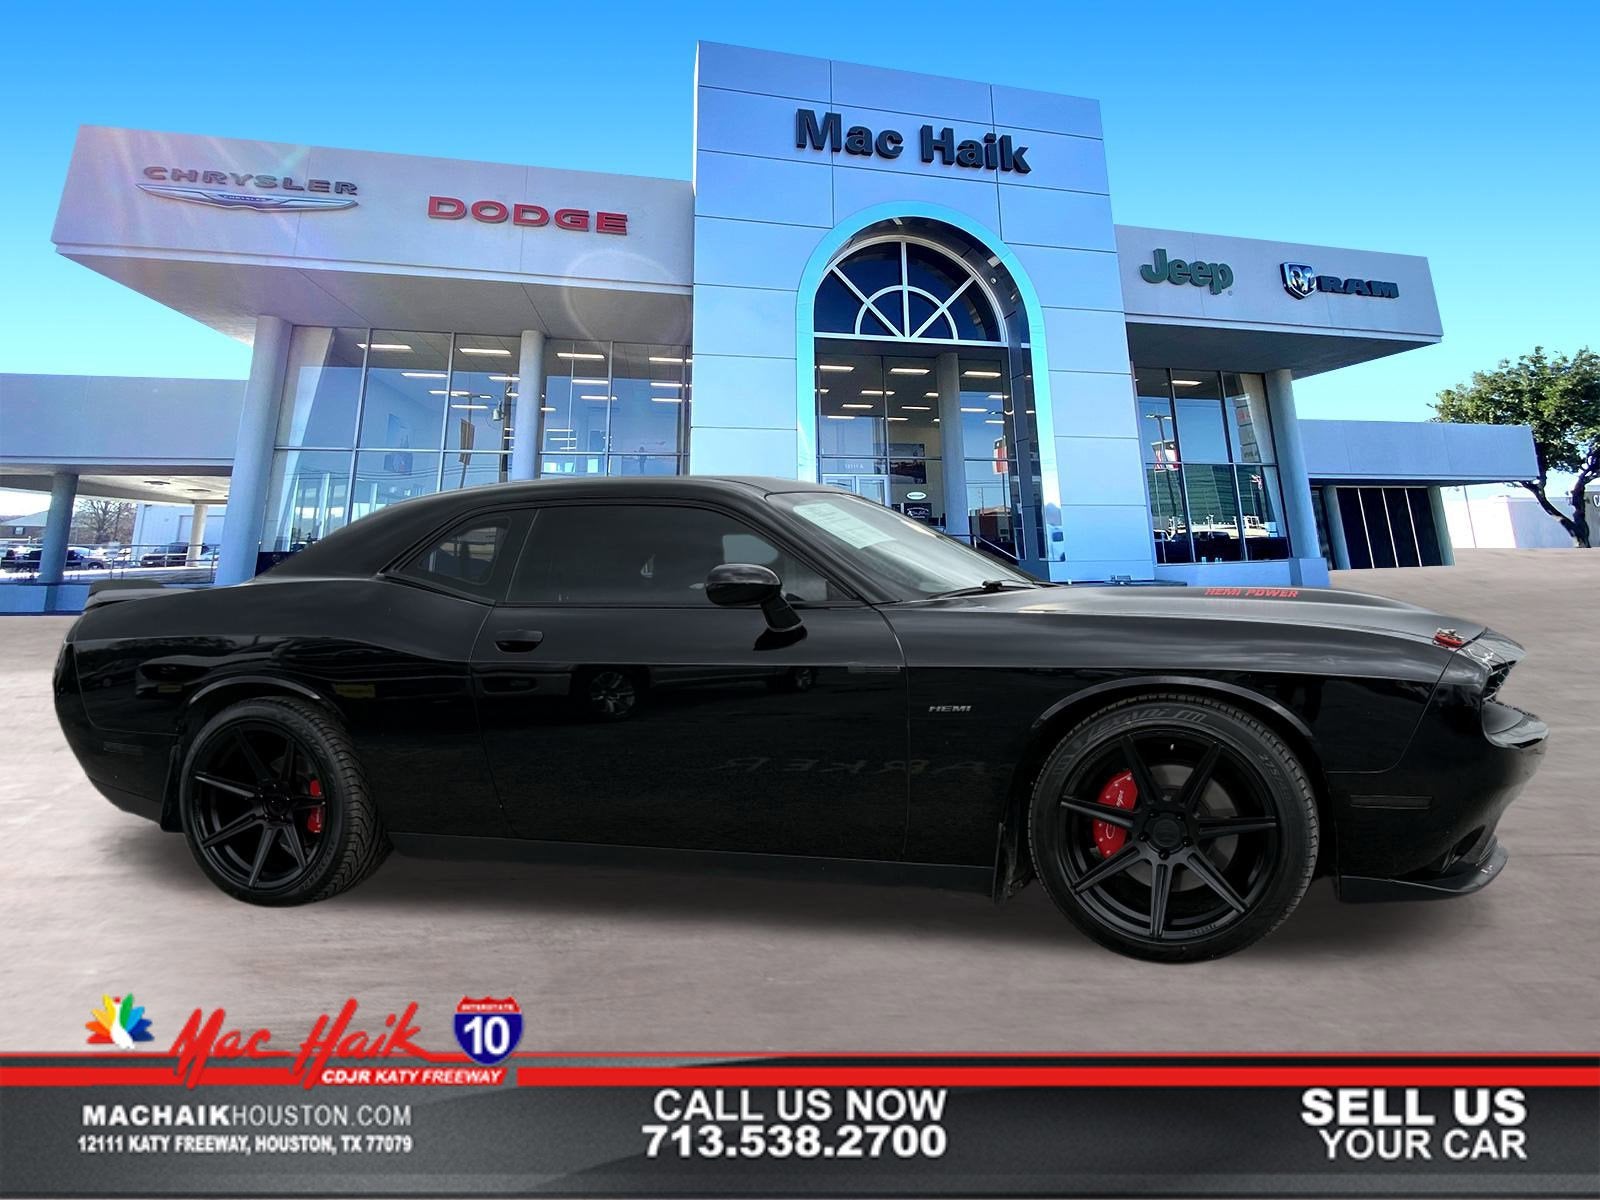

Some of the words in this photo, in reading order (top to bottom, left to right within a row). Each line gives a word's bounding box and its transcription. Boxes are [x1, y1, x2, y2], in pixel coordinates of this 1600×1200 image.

[795, 108, 904, 159] Mac
[919, 125, 1032, 174] Haik
[143, 166, 359, 196] CHRYSLER
[428, 195, 628, 236] DODGE
[1139, 248, 1234, 295] Jeep
[1315, 275, 1399, 299] RAM
[1204, 587, 1242, 597] HEMI
[1245, 588, 1299, 598] POWER
[928, 705, 972, 713] HEMI
